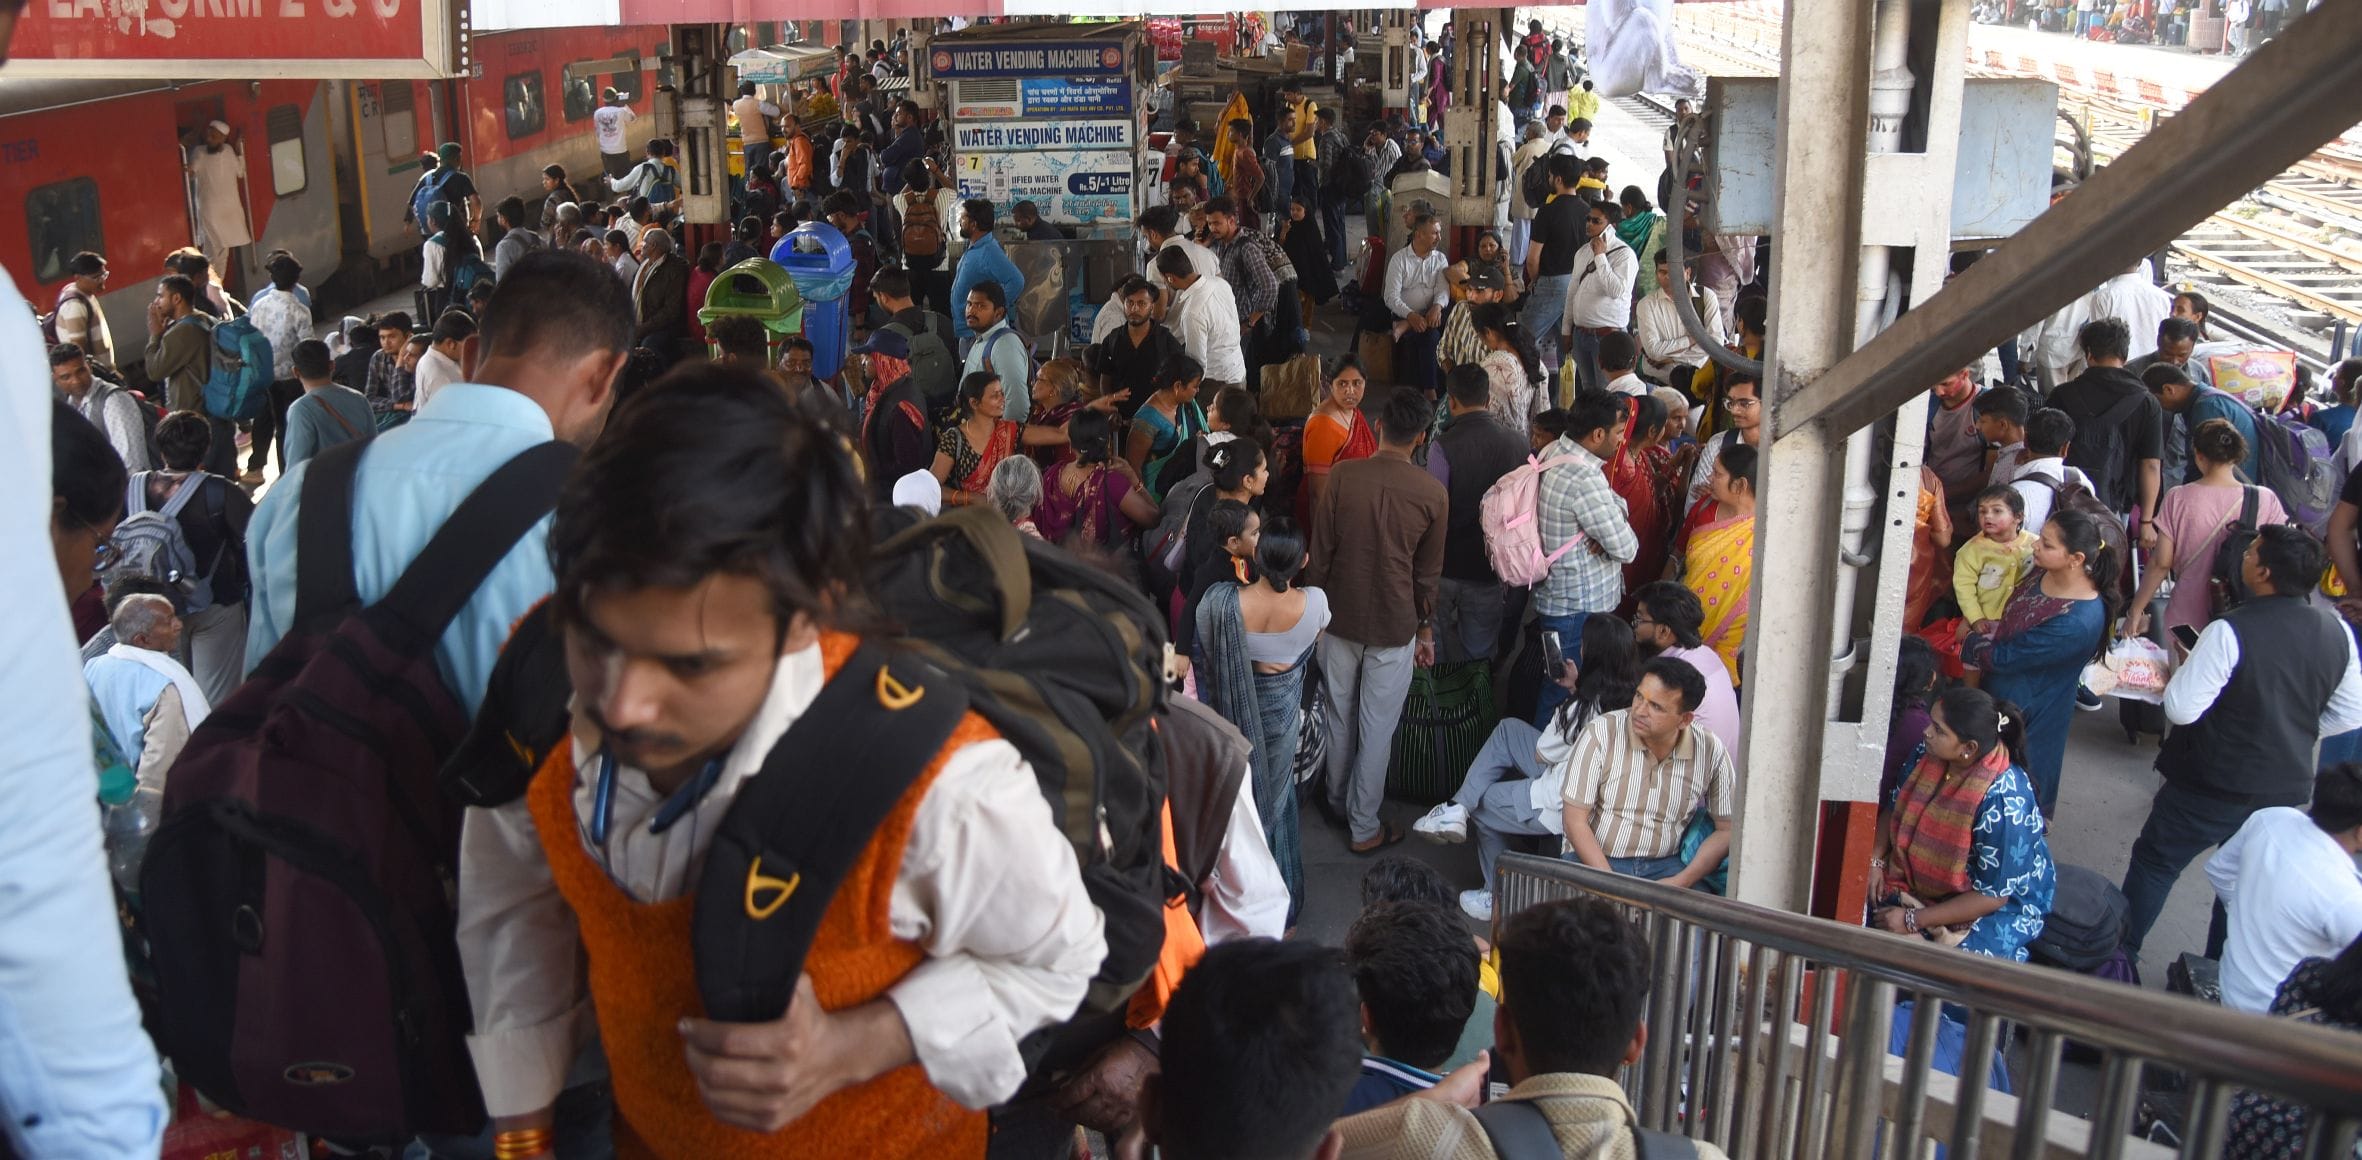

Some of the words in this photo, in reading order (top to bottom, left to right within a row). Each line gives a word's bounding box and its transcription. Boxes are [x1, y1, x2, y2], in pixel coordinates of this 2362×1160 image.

[954, 51, 992, 71] WATER
[996, 50, 1044, 70] VENDING
[1048, 49, 1100, 69] MACHINE
[959, 129, 1003, 147] WATER
[1006, 128, 1061, 145] VENDING
[1065, 125, 1124, 144] MACHINE
[970, 157, 979, 170] 7
[1034, 175, 1059, 184] WATER
[1112, 176, 1130, 186] Litre
[1148, 168, 1159, 187] 7
[958, 178, 971, 198] 5
[1030, 186, 1063, 196] MACHINE
